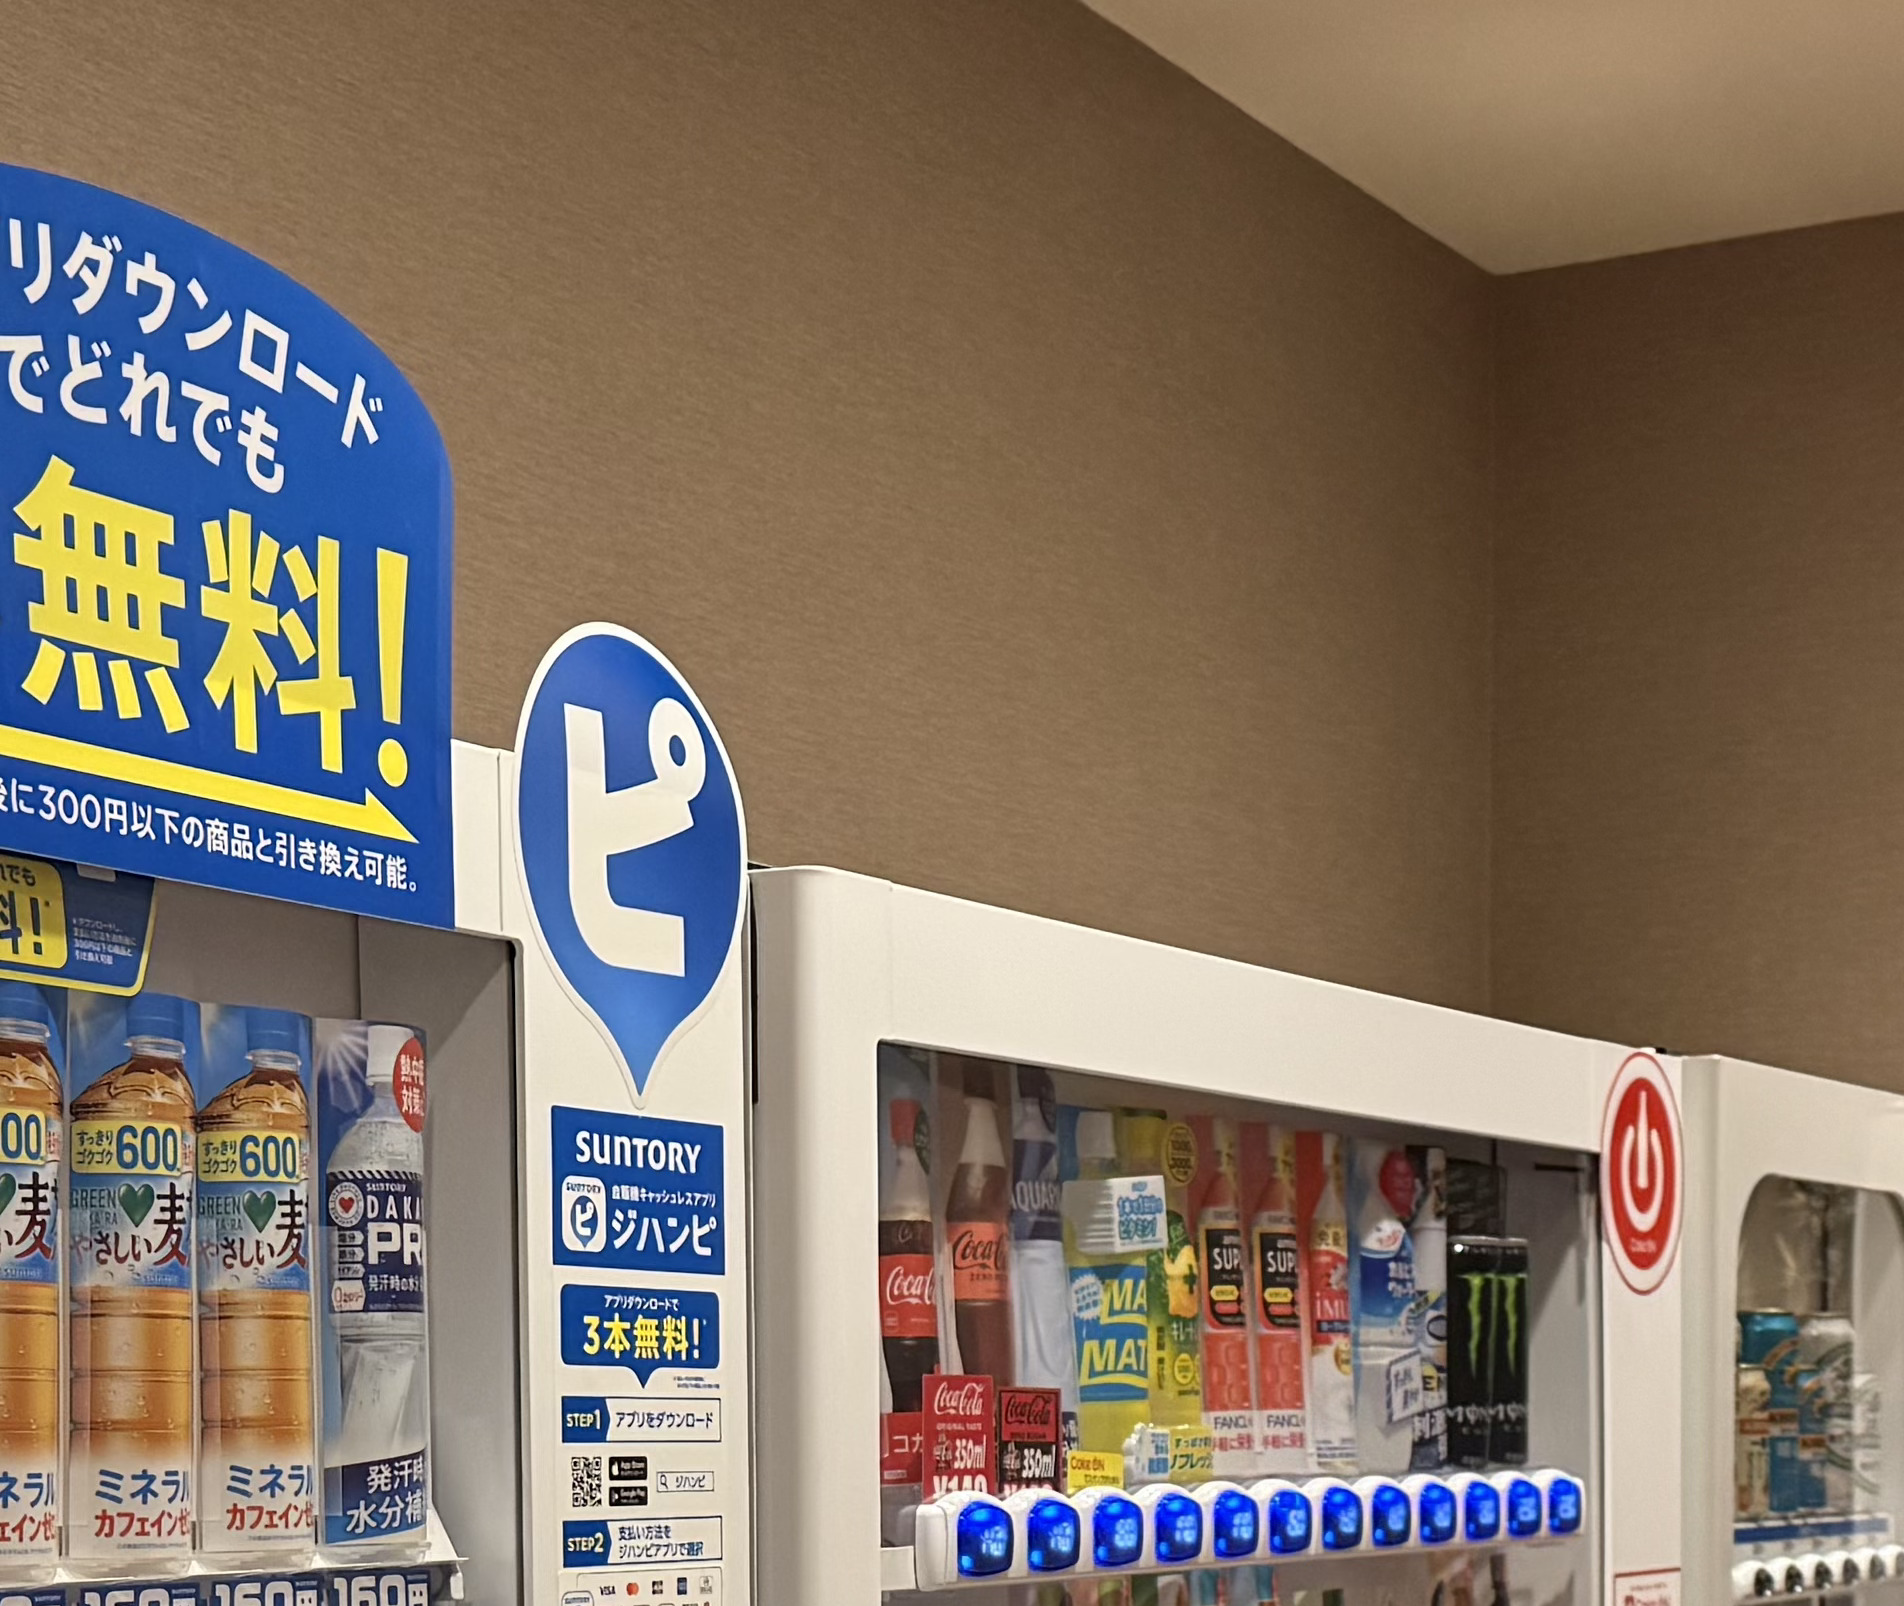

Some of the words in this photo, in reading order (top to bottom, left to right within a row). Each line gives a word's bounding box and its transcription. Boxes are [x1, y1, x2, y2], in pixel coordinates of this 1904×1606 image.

[564, 697, 707, 978] ピ
[76, 1129, 114, 1147] すっきり
[116, 1125, 180, 1172] 600
[576, 1130, 701, 1174] SUNTORY
[76, 1147, 114, 1166] ゴクゴク
[612, 1209, 717, 1256] ジハンピ
[583, 1313, 701, 1360] 3本無料!
[566, 1409, 601, 1430] STEP1
[616, 1411, 714, 1429] アプリをダウンロード
[568, 1533, 604, 1552] STEP2
